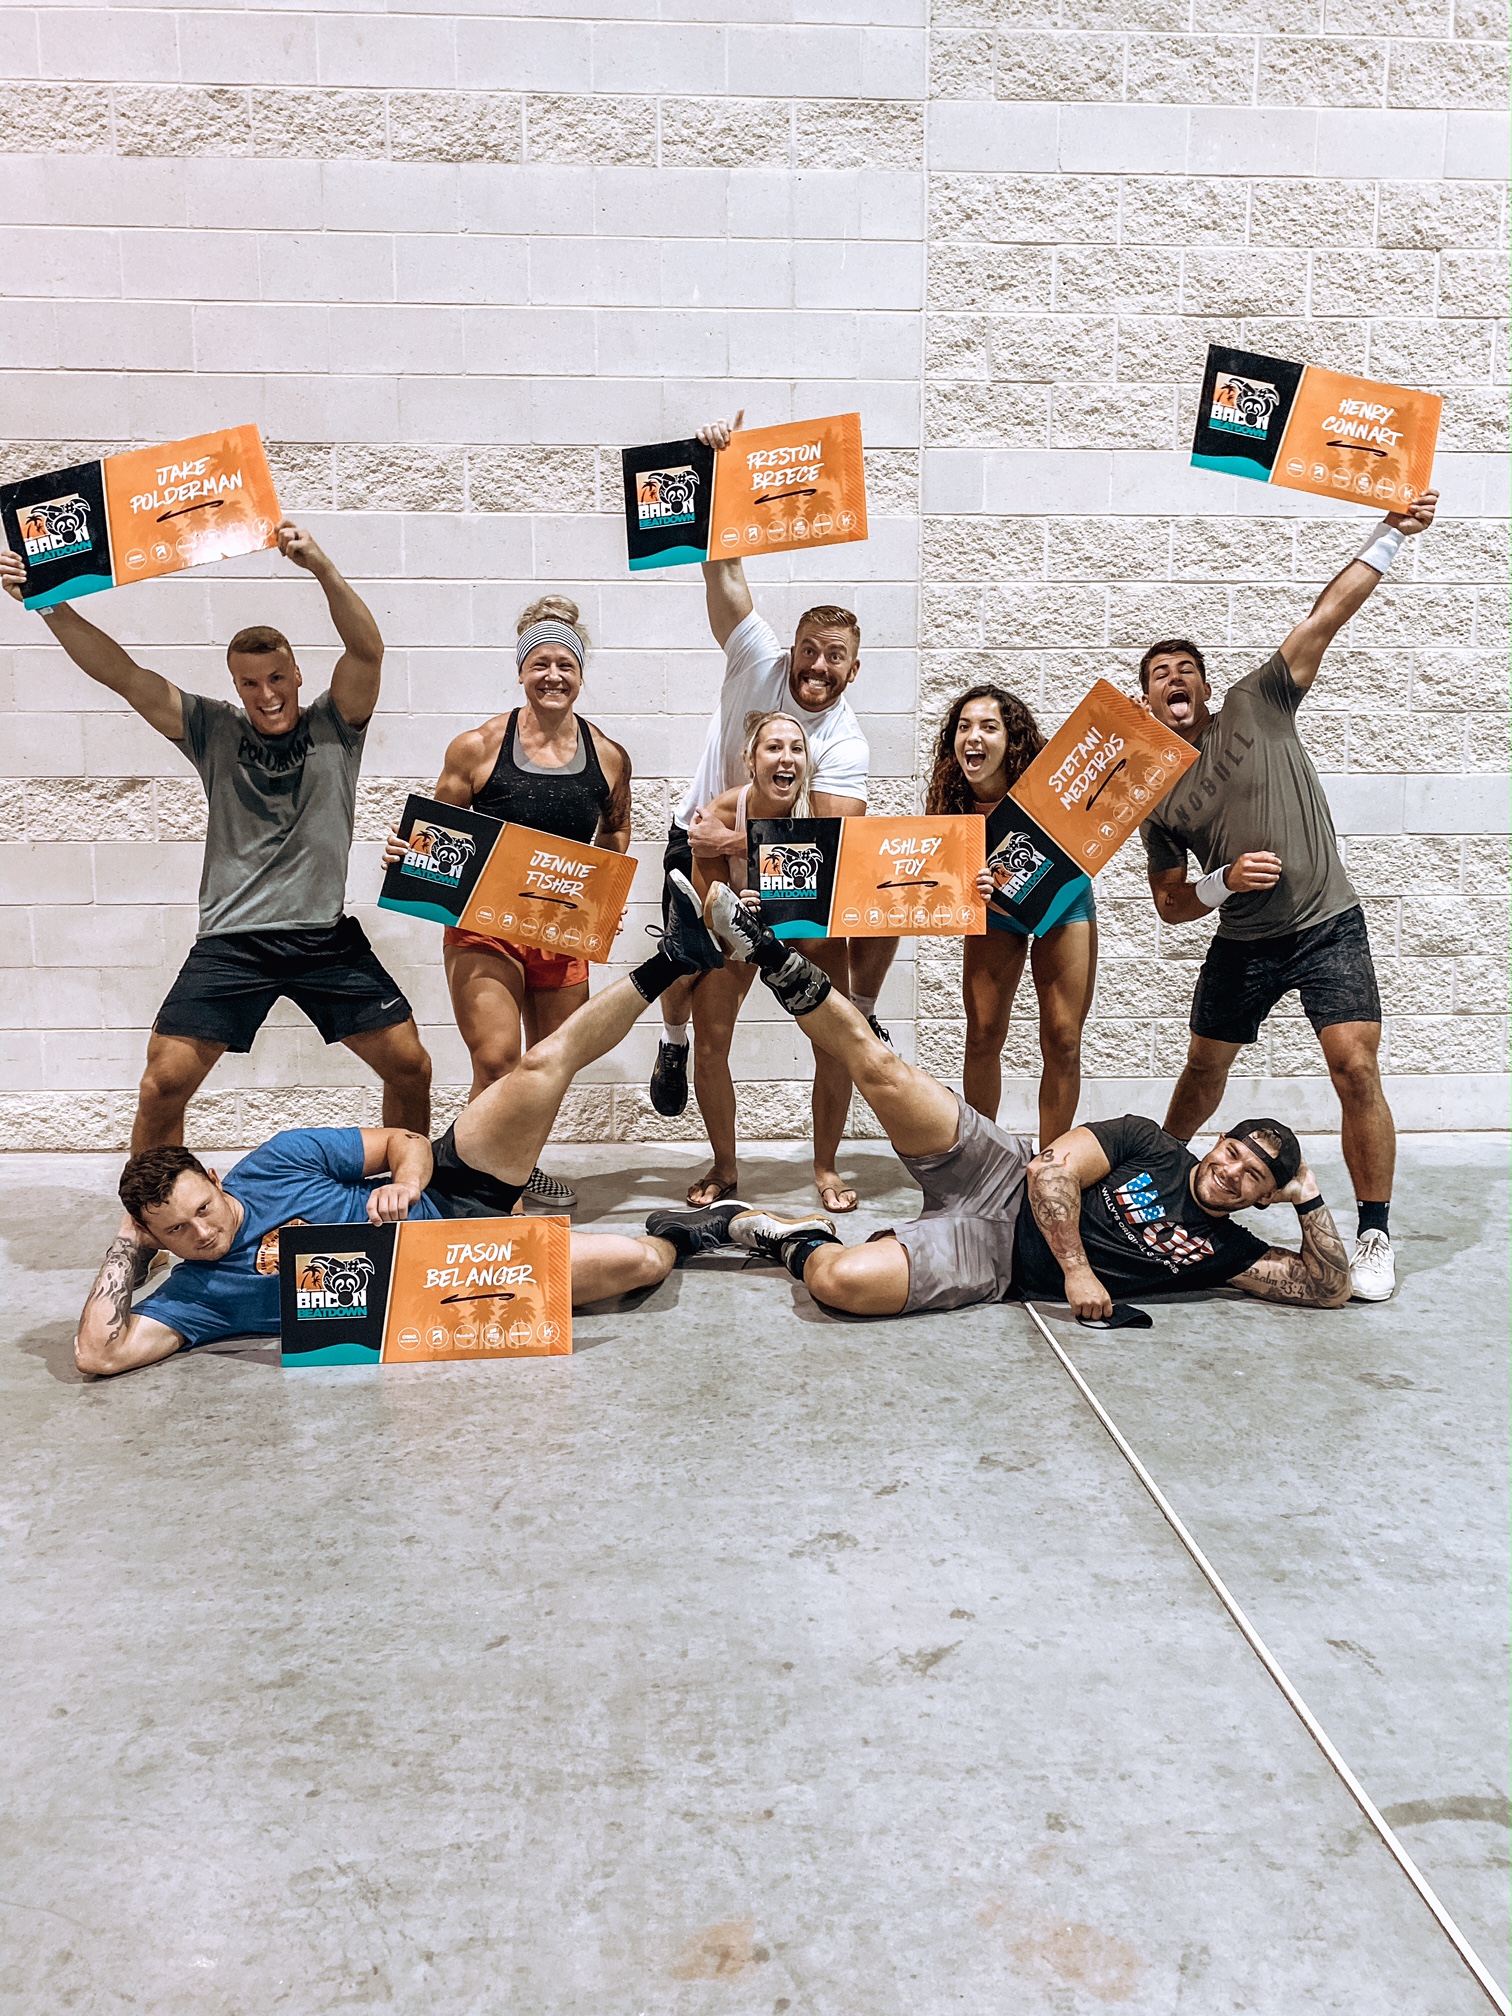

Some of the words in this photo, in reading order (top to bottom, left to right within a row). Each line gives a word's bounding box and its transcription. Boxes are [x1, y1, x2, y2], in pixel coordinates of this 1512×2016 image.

[1338, 398, 1395, 425] HENRY
[1321, 416, 1404, 446] CONNART
[746, 440, 822, 470] PRESTON
[156, 456, 211, 486] JAKE
[750, 463, 825, 490] BREECE
[129, 469, 243, 514] POLDERMAN
[638, 512, 696, 528] BEATDOWN
[28, 540, 93, 565] BEATDOWN
[1048, 726, 1104, 793] STEFANI
[1059, 732, 1125, 811] MEDEIROS
[1174, 731, 1255, 827] NOBULL
[878, 837, 942, 857] ASHLEY
[401, 863, 460, 887] BEATDOWN
[528, 850, 597, 879] JENNIE
[892, 858, 927, 877] FOY
[526, 870, 584, 900] FISHER
[759, 889, 818, 899] BEATDOWN
[1101, 1186, 1121, 1221] WILLY'S
[446, 1240, 513, 1265] JASON
[423, 1264, 537, 1289] BELANGER
[1241, 1267, 1278, 1286] Psalm
[296, 1290, 368, 1308] BACON
[296, 1306, 368, 1318] BEATDOWN
